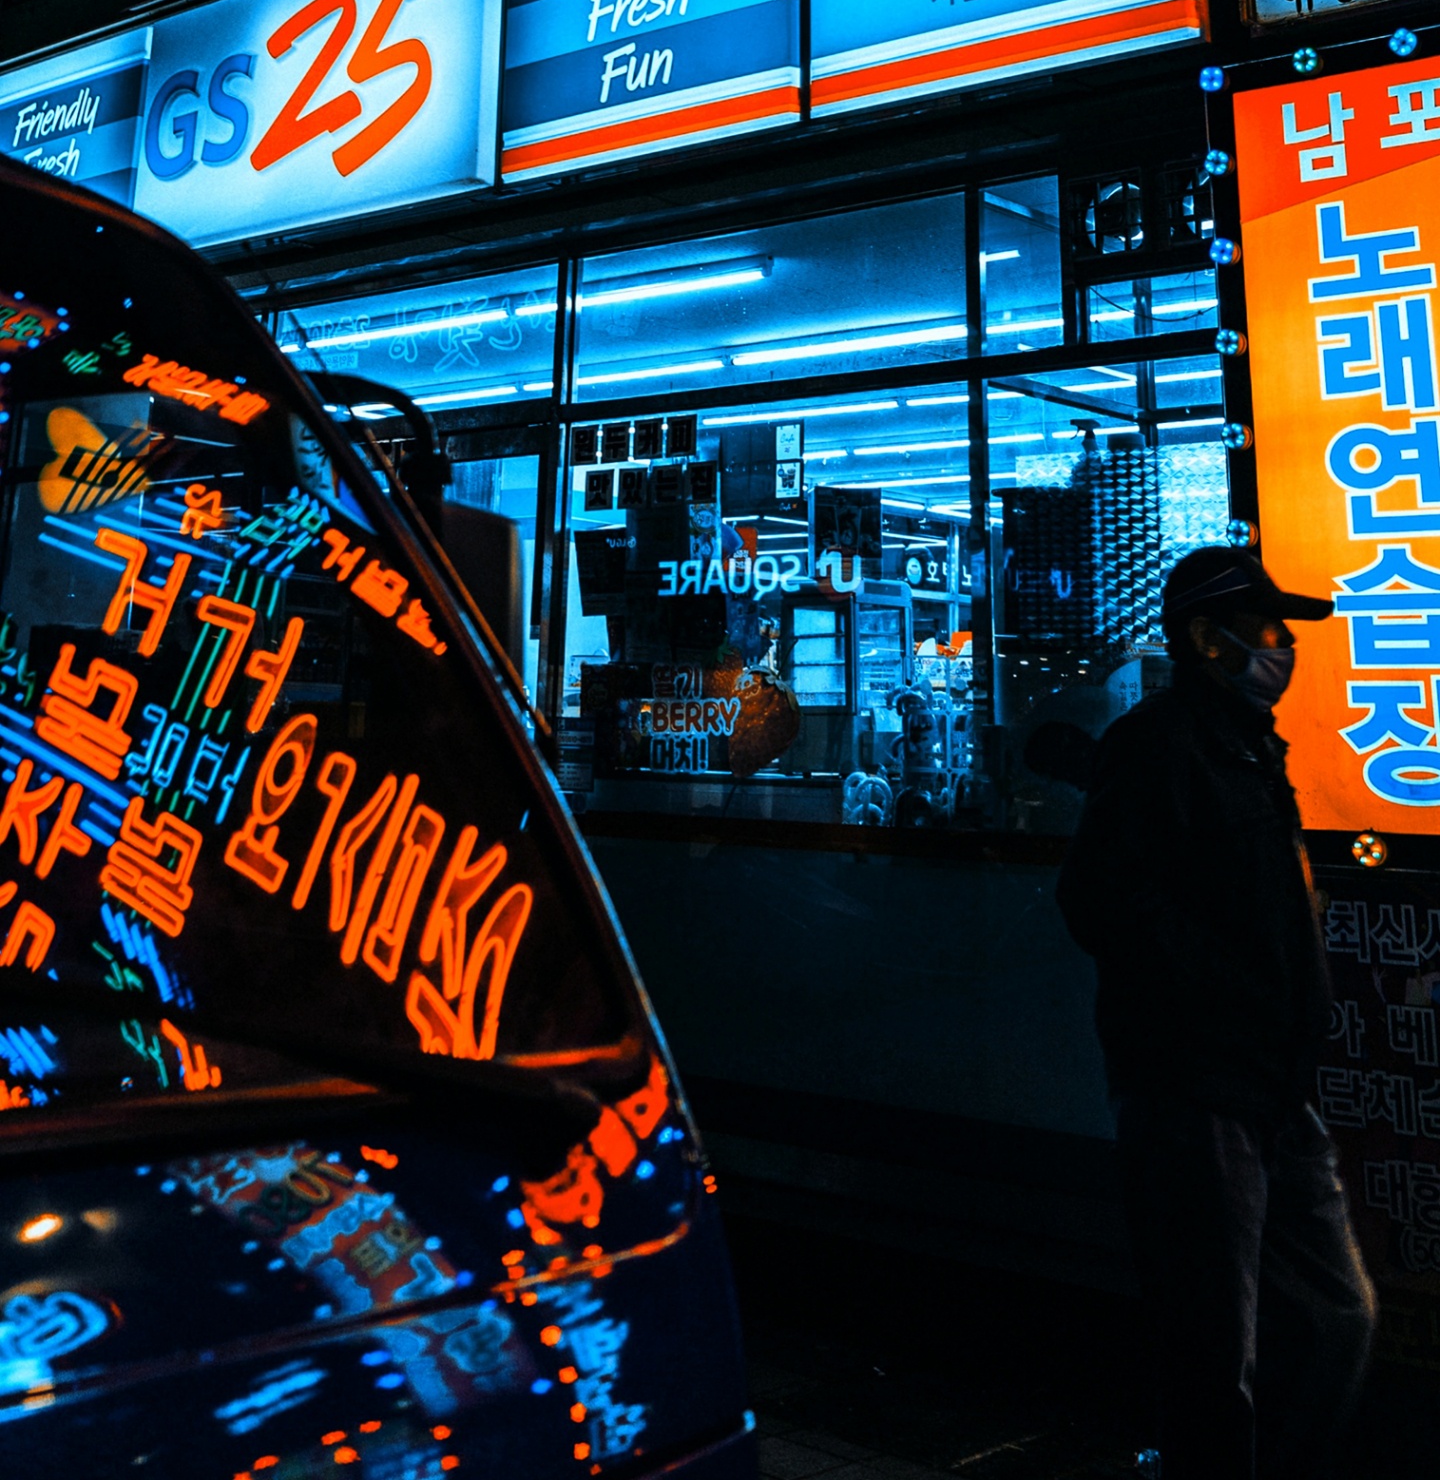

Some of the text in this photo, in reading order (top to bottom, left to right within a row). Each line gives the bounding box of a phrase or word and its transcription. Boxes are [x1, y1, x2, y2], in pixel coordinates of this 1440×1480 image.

[599, 39, 674, 104] Fun
[12, 86, 101, 147] Friendly
[1281, 76, 1440, 183] 남포
[652, 698, 741, 737] BERRY
